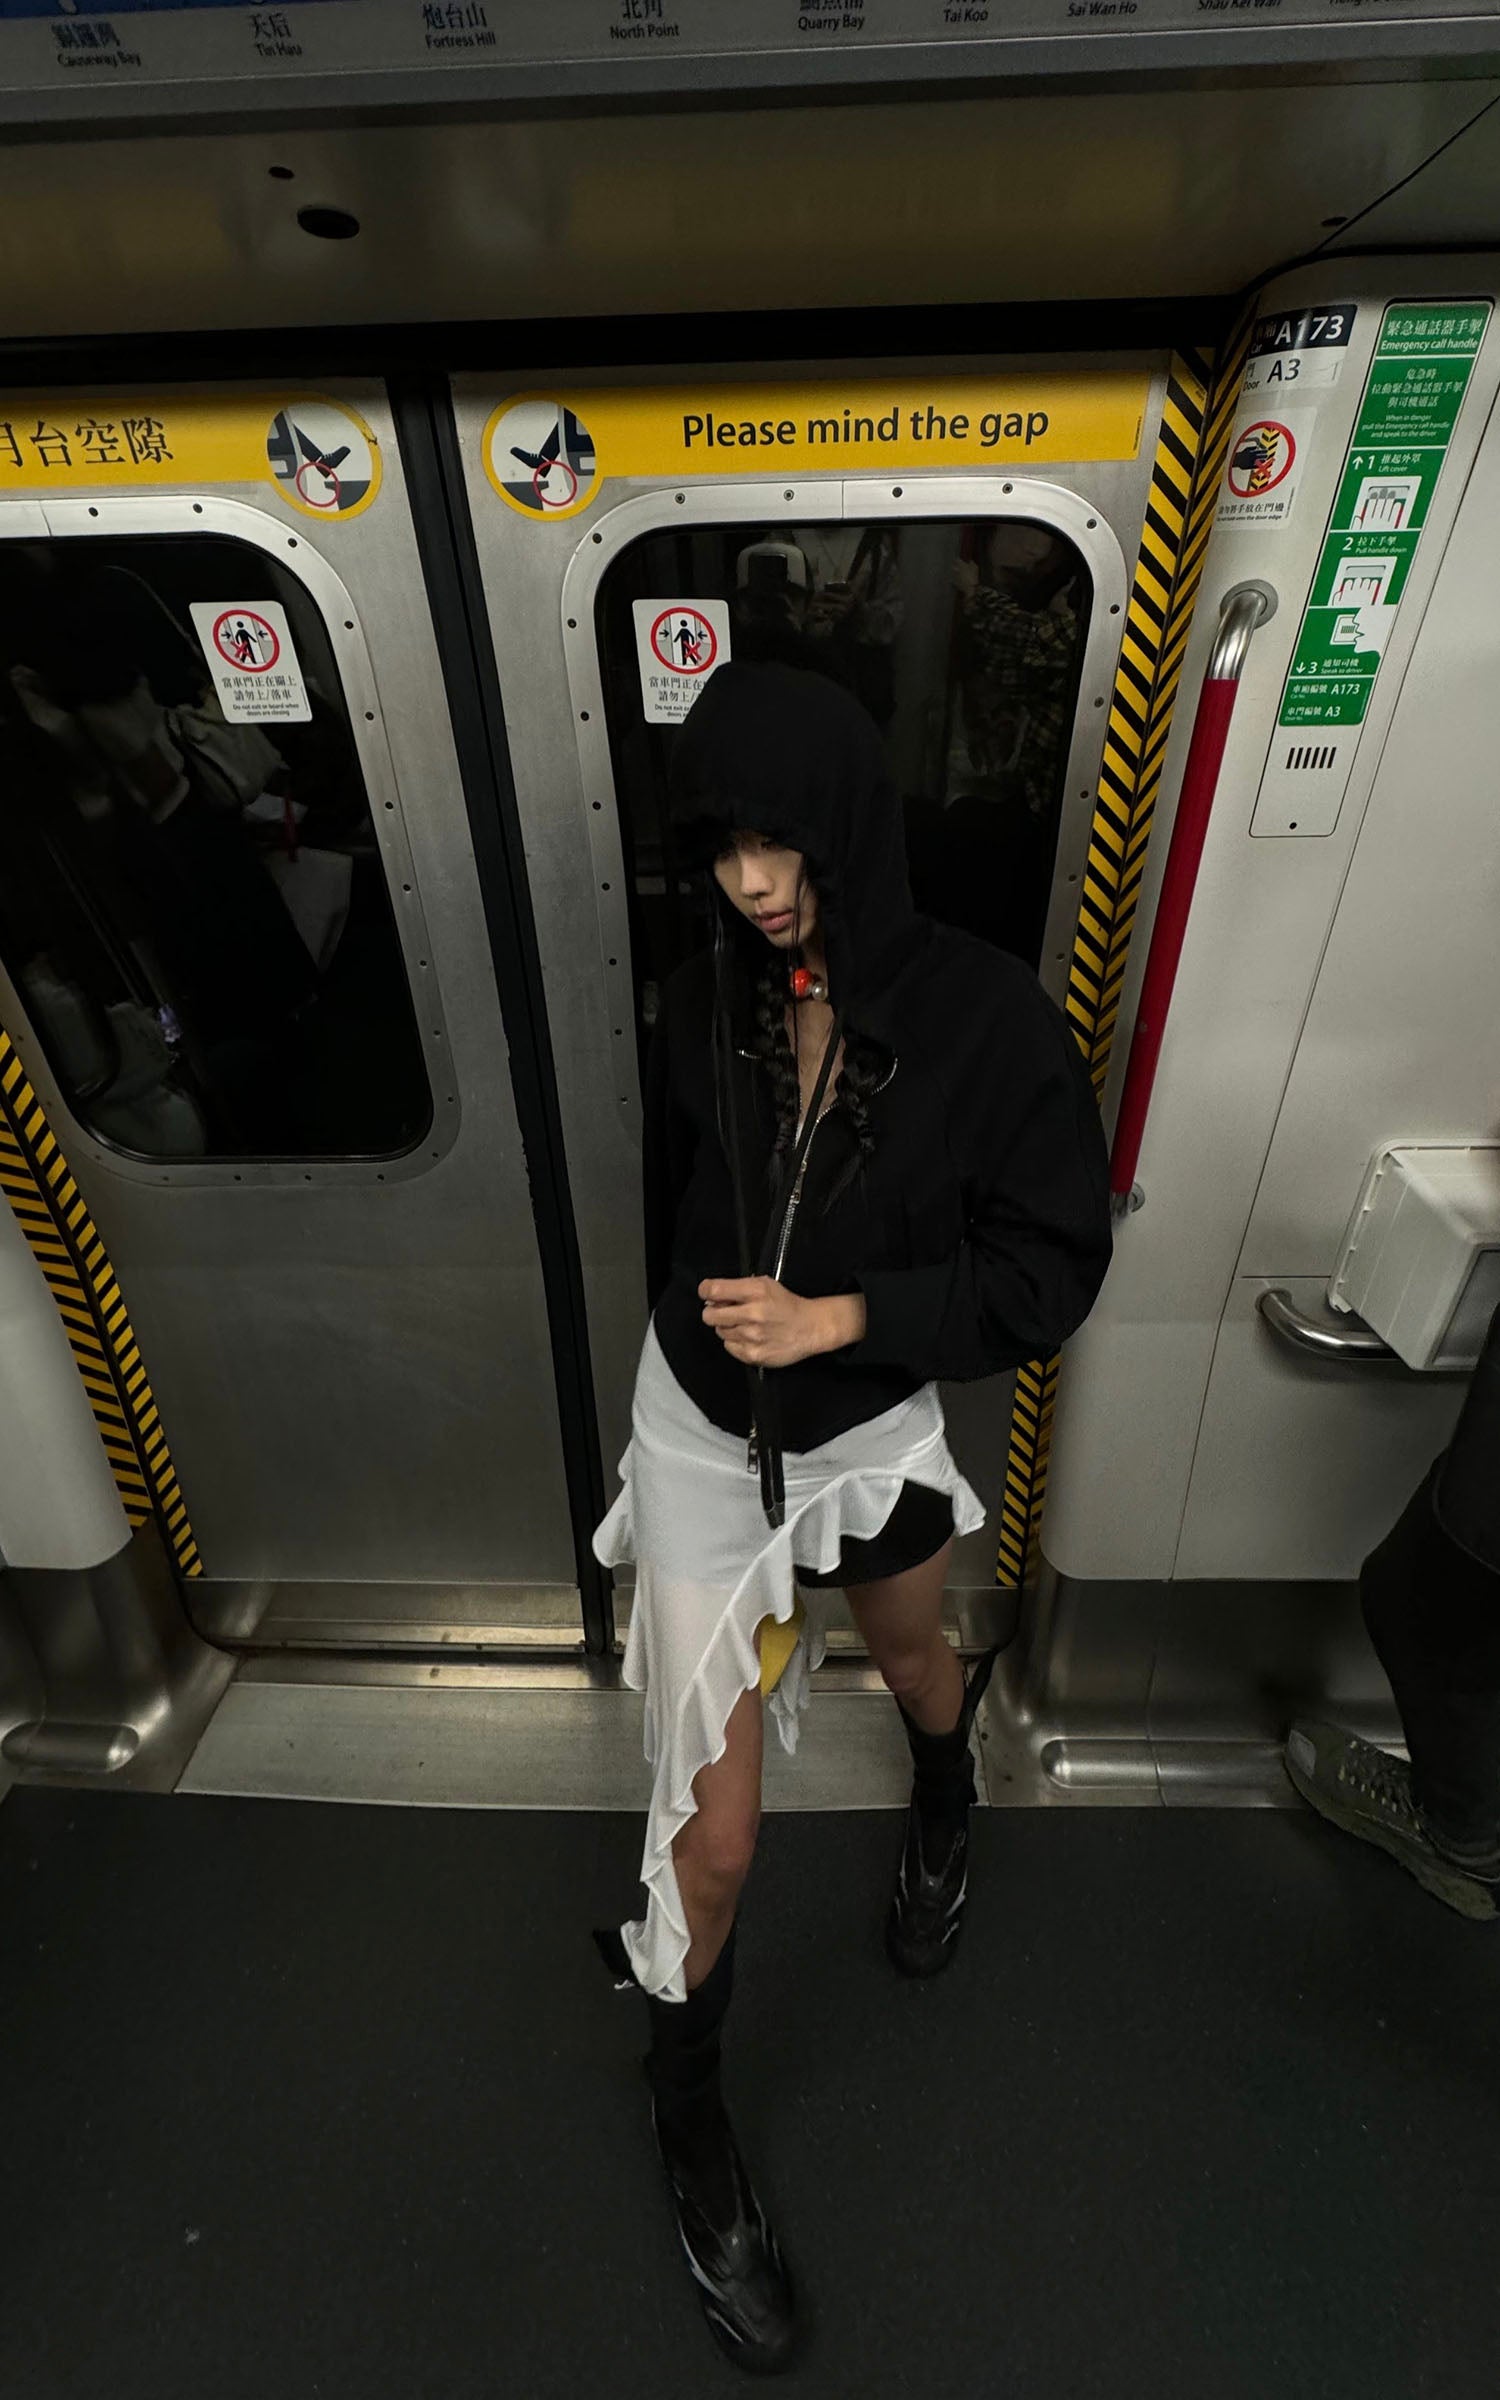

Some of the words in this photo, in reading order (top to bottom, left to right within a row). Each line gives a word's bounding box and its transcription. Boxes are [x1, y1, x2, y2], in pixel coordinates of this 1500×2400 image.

[944, 10, 961, 22] Tai
[964, 8, 988, 22] Koo
[1068, 2, 1086, 17] Sai
[1090, 2, 1116, 16] Wan
[1119, 1, 1137, 15] Ho
[610, 23, 645, 39] North
[647, 22, 680, 38] Point
[798, 16, 839, 31] Quarry
[843, 14, 865, 31] Bay
[425, 34, 474, 48] Fortress
[475, 31, 496, 47] Hill
[1274, 314, 1345, 346] A173
[1381, 340, 1430, 352] Emergency
[1431, 339, 1447, 349] call
[1448, 338, 1478, 349] handle
[1267, 358, 1301, 383] A3
[682, 412, 796, 448] Please
[807, 407, 899, 444] mind
[910, 405, 970, 441] the
[980, 408, 1049, 447] gap
[1368, 454, 1375, 470] 1
[1342, 536, 1354, 551] 2
[1307, 661, 1318, 674] 3
[649, 676, 707, 690] 當車門正在
[1330, 683, 1360, 695] A173
[1324, 706, 1341, 717] A3
